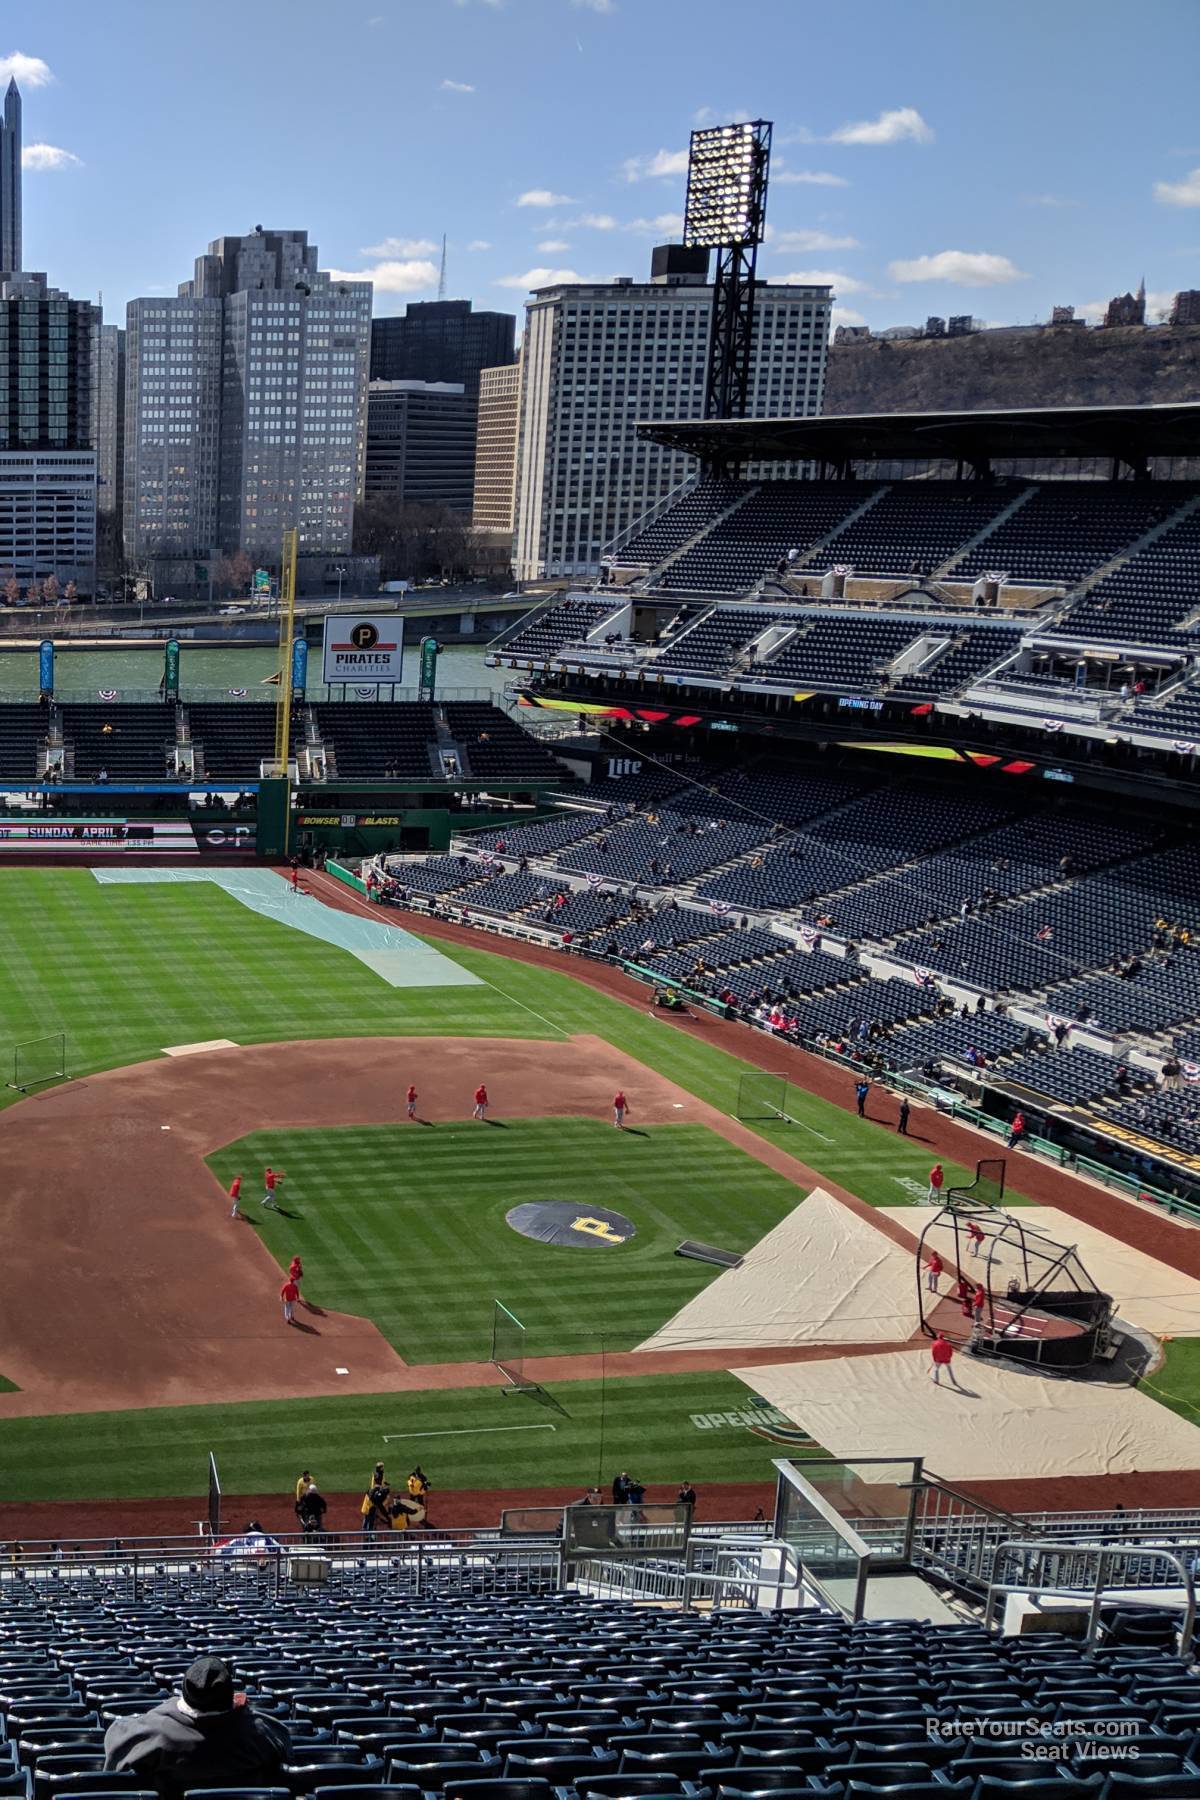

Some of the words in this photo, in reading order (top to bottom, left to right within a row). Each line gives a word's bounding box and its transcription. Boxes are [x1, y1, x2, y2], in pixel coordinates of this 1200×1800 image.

[336, 653, 391, 664] PIRATES
[335, 665, 391, 673] CHARITIES
[839, 698, 870, 709] OPENING
[869, 701, 885, 710] DAY
[607, 758, 642, 779] Lite
[304, 817, 340, 825] BOWSER
[365, 817, 400, 825] BLASTS
[82, 827, 118, 838] APRIL
[121, 827, 129, 838] 7
[689, 1409, 792, 1429] OPENIN
